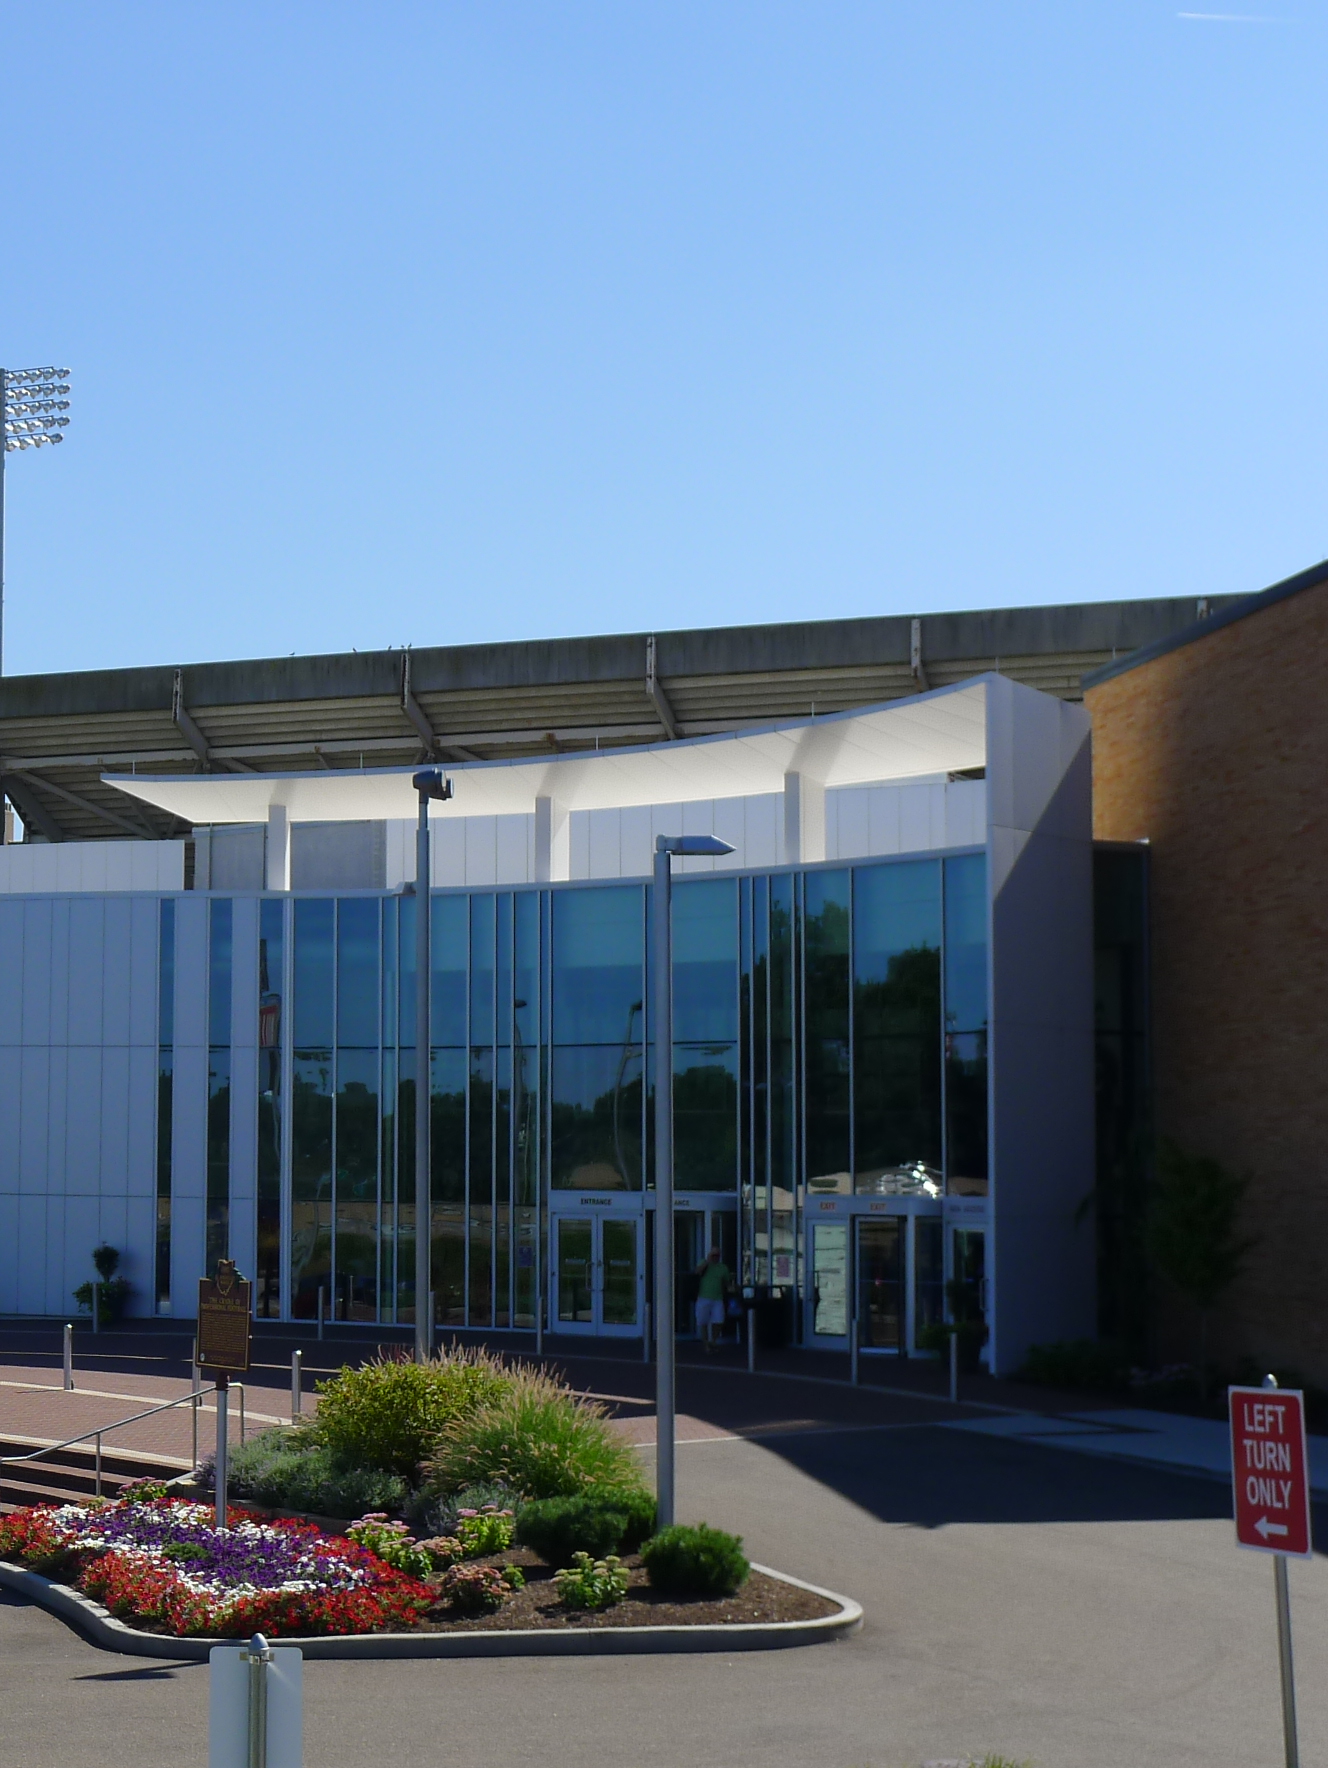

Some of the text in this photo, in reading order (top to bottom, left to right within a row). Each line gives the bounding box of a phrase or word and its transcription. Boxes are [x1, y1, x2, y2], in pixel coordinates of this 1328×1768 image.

[580, 1198, 612, 1206] ENTRANCE
[820, 1201, 836, 1211] EXIT
[870, 1202, 886, 1211] EXIT
[1243, 1402, 1286, 1435] LEFT
[1243, 1439, 1291, 1473] TURN
[1246, 1475, 1292, 1510] ONLY
